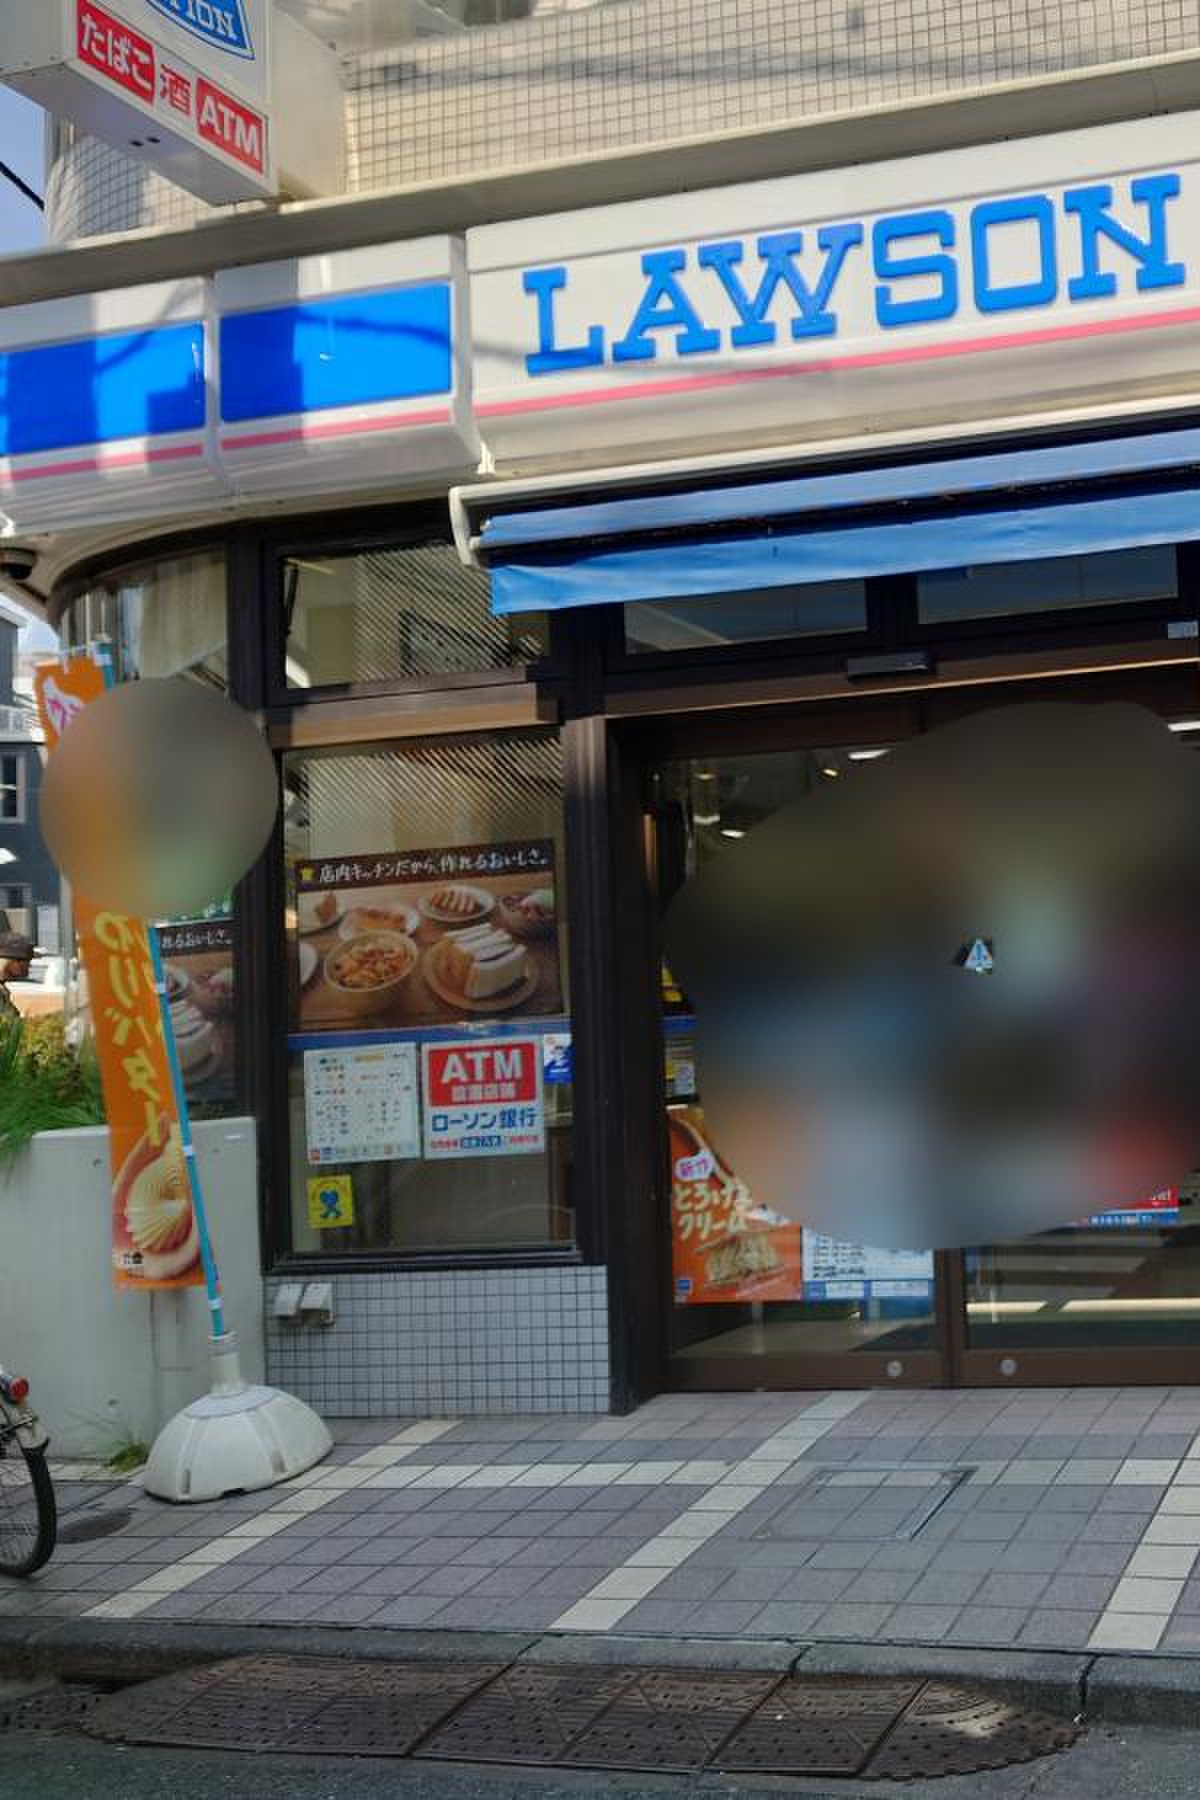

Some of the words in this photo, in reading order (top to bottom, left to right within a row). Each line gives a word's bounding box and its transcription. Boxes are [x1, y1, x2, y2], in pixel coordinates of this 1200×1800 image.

[82, 14, 153, 89] たばこ
[160, 66, 191, 118] 酒
[200, 95, 260, 162] ATM
[522, 173, 1186, 377] LAWSON
[441, 1049, 523, 1084] ATM
[432, 1107, 538, 1132] ローソン銀行
